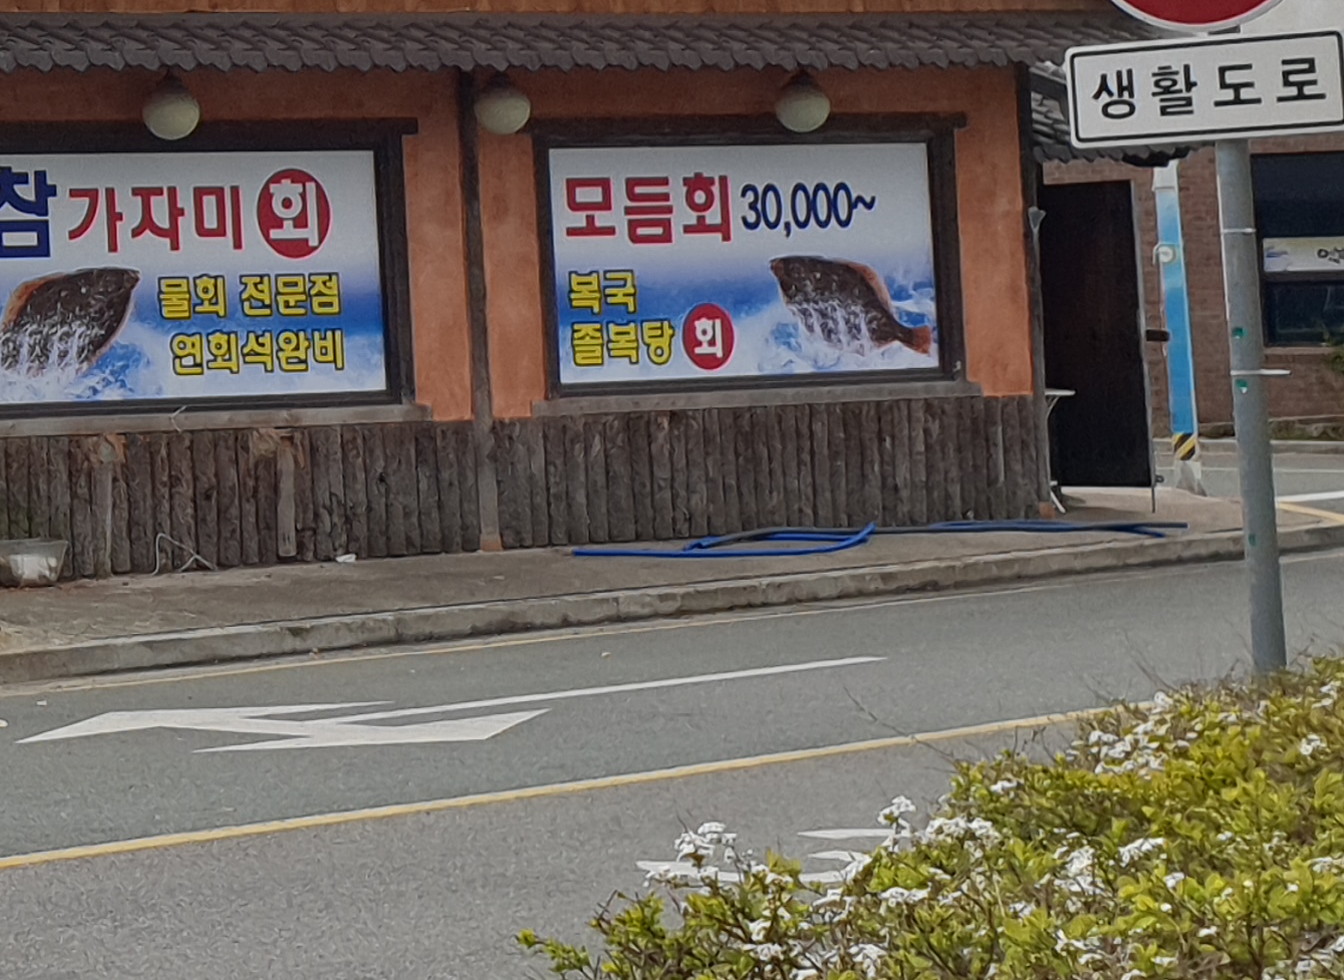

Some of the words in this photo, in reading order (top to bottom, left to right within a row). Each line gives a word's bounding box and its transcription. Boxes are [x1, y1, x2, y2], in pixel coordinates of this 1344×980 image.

[1090, 56, 1328, 120] 생활도로
[266, 177, 319, 248] 회
[562, 171, 734, 243] 모듬회
[739, 179, 876, 238] 30,000~
[157, 274, 226, 320] 물회
[239, 271, 342, 317] 전문점
[567, 269, 637, 315] 복국
[170, 327, 345, 377] 연회석완비
[570, 319, 676, 368] 졸복탕
[693, 313, 725, 361] 회
